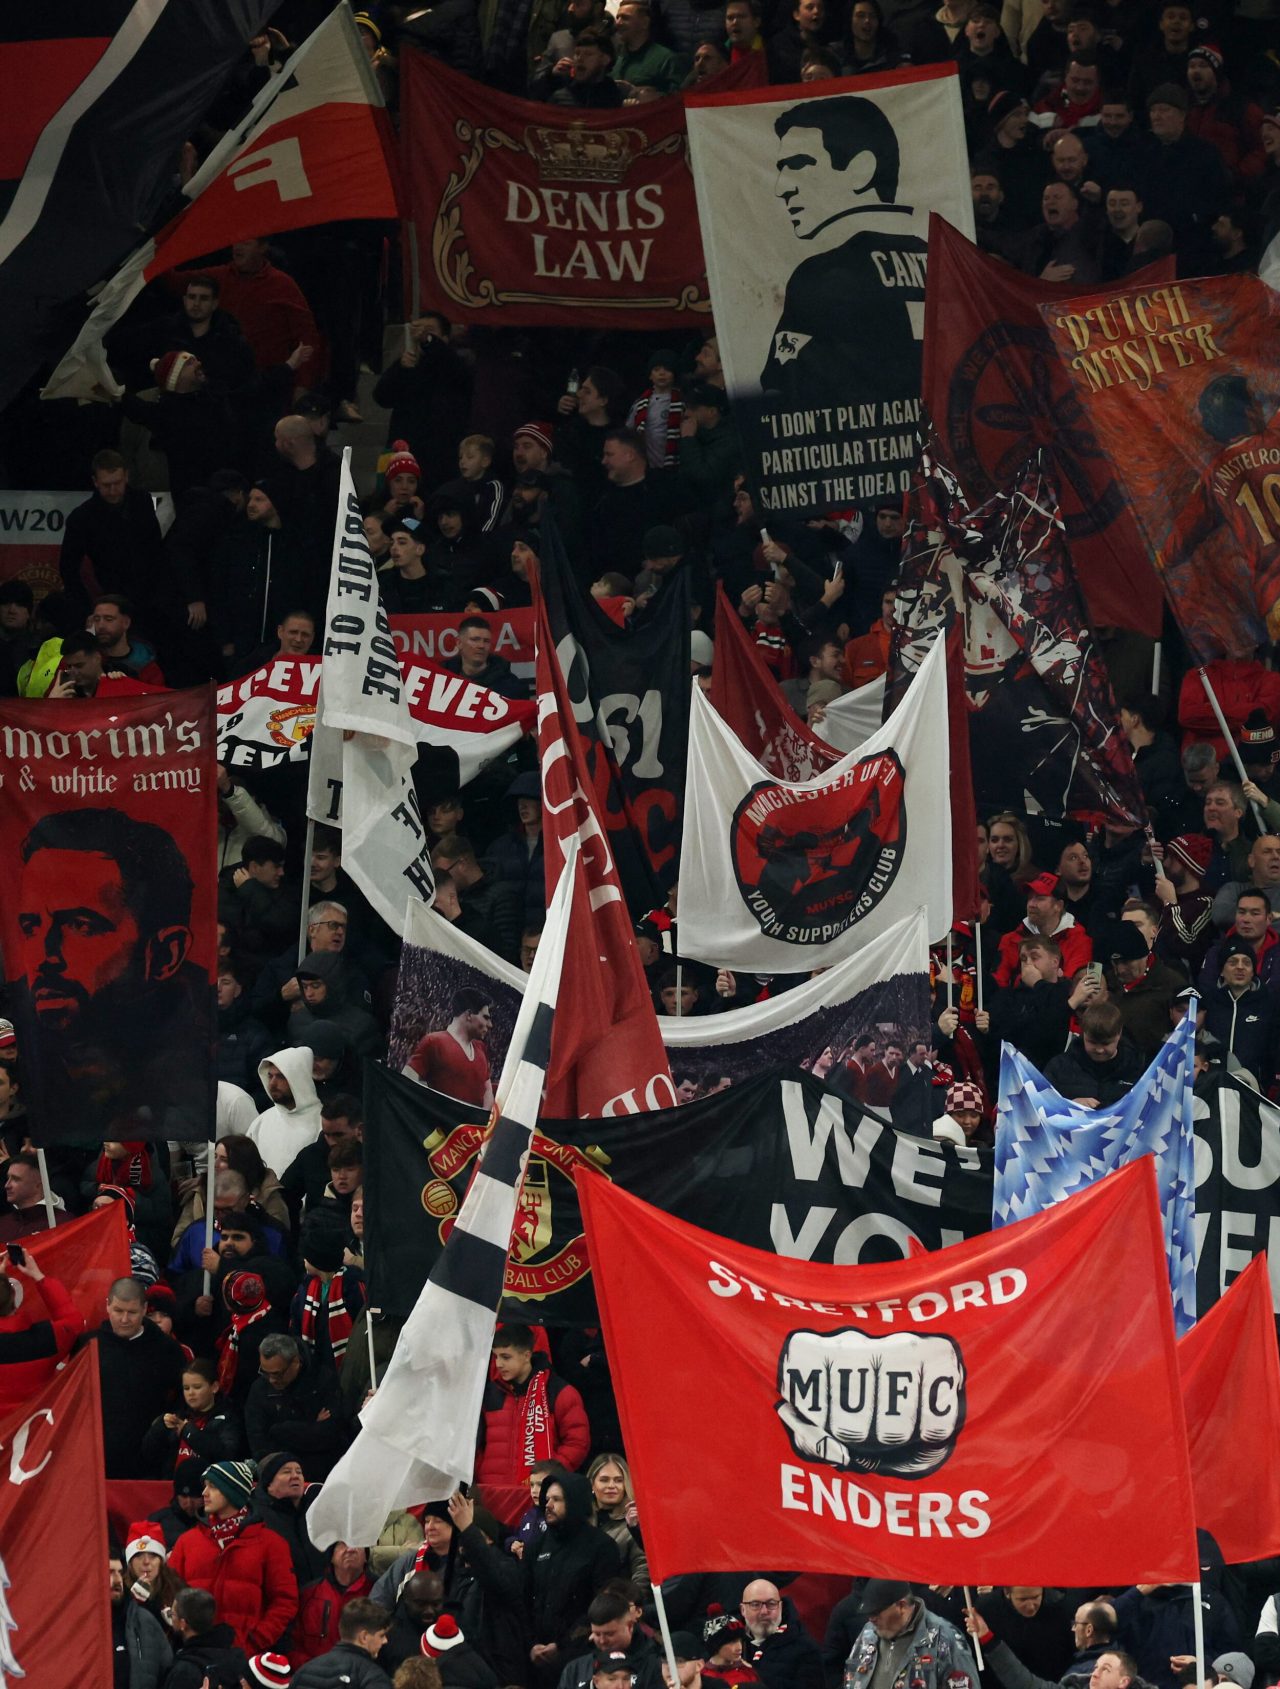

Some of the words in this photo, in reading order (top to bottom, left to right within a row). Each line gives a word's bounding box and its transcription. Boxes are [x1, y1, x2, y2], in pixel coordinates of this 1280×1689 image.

[504, 180, 665, 232] DENIS
[531, 233, 654, 283] LAW
[871, 250, 928, 288] CANT
[1056, 286, 1191, 352] DUTCH
[1071, 323, 1227, 394] MASTER
[782, 407, 833, 438] DON'T
[837, 403, 876, 431] PLAY
[882, 399, 922, 425] AGAI
[762, 441, 865, 476] PARTICULAR
[867, 434, 914, 463] TEAM
[824, 477, 855, 503] THE
[858, 471, 897, 499] IDEA
[50, 765, 118, 798] white
[133, 766, 201, 793] army
[748, 889, 783, 936] YOUTH
[869, 847, 897, 893] CLUB
[434, 1129, 484, 1174] MANCH
[780, 1079, 982, 1208] WE'
[505, 1268, 543, 1288] BALL
[544, 1254, 583, 1285] CLUB
[787, 1368, 955, 1417] MUFC
[535, 1404, 545, 1433] UTD
[780, 1463, 991, 1539] ENDERS
